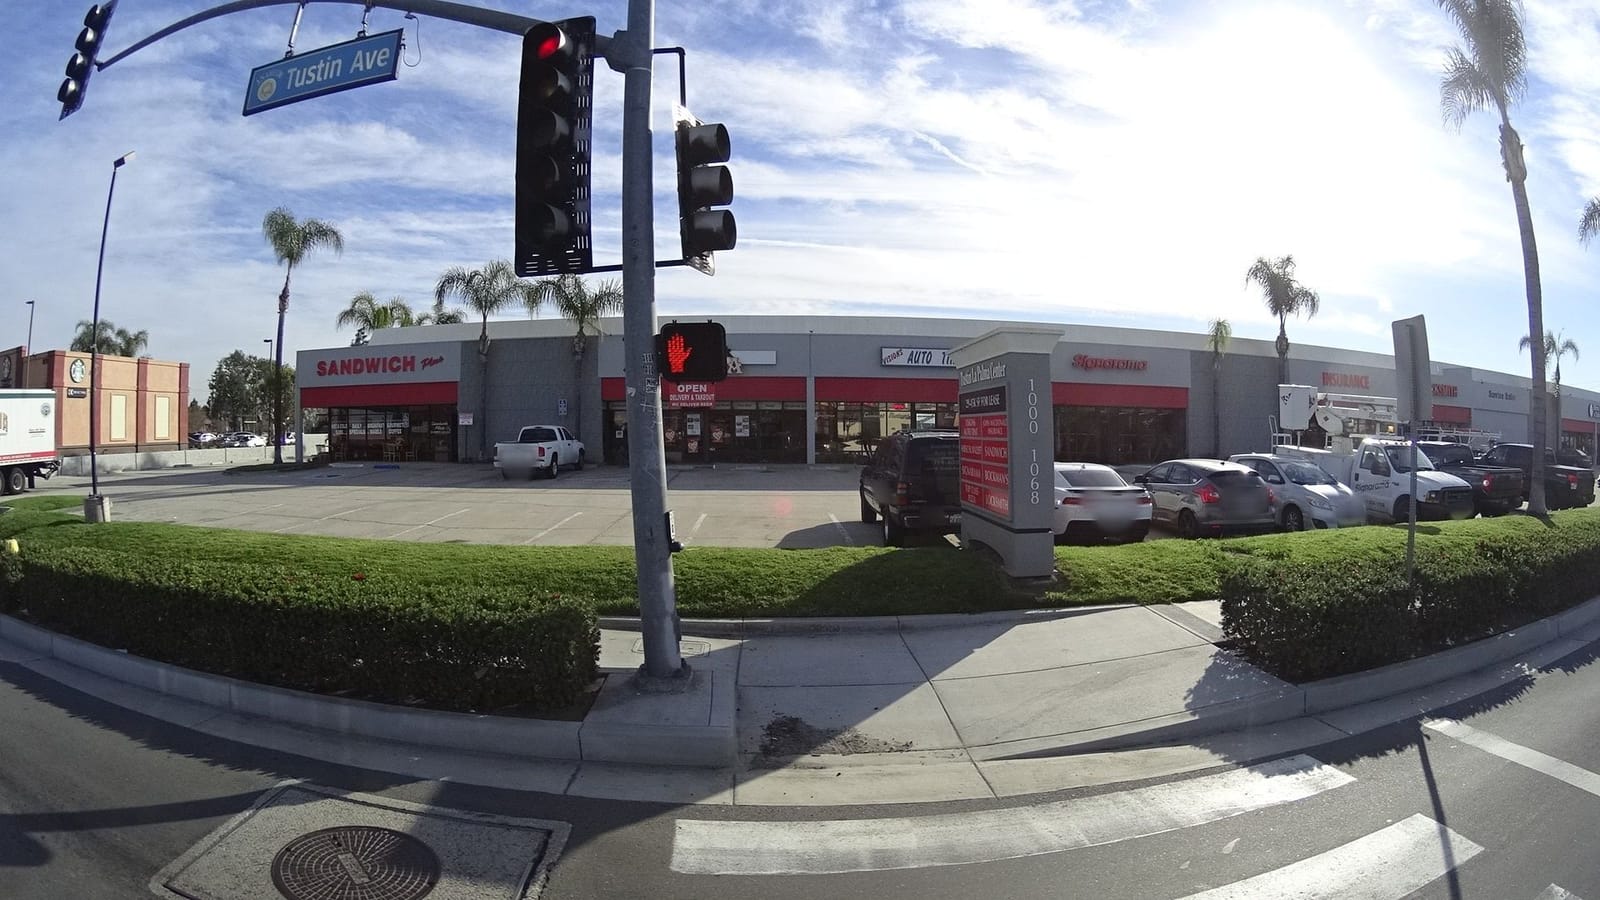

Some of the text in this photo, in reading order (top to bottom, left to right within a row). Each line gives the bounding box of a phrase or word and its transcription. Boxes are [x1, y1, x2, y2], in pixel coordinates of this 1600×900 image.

[287, 56, 343, 90] Tustin
[350, 47, 390, 74] Ave
[317, 355, 416, 377] SANDWICH
[907, 350, 933, 365] AUTO
[669, 393, 690, 401] DELIVERY
[677, 384, 708, 393] OPEN
[1028, 378, 1040, 505] 1000 1068
